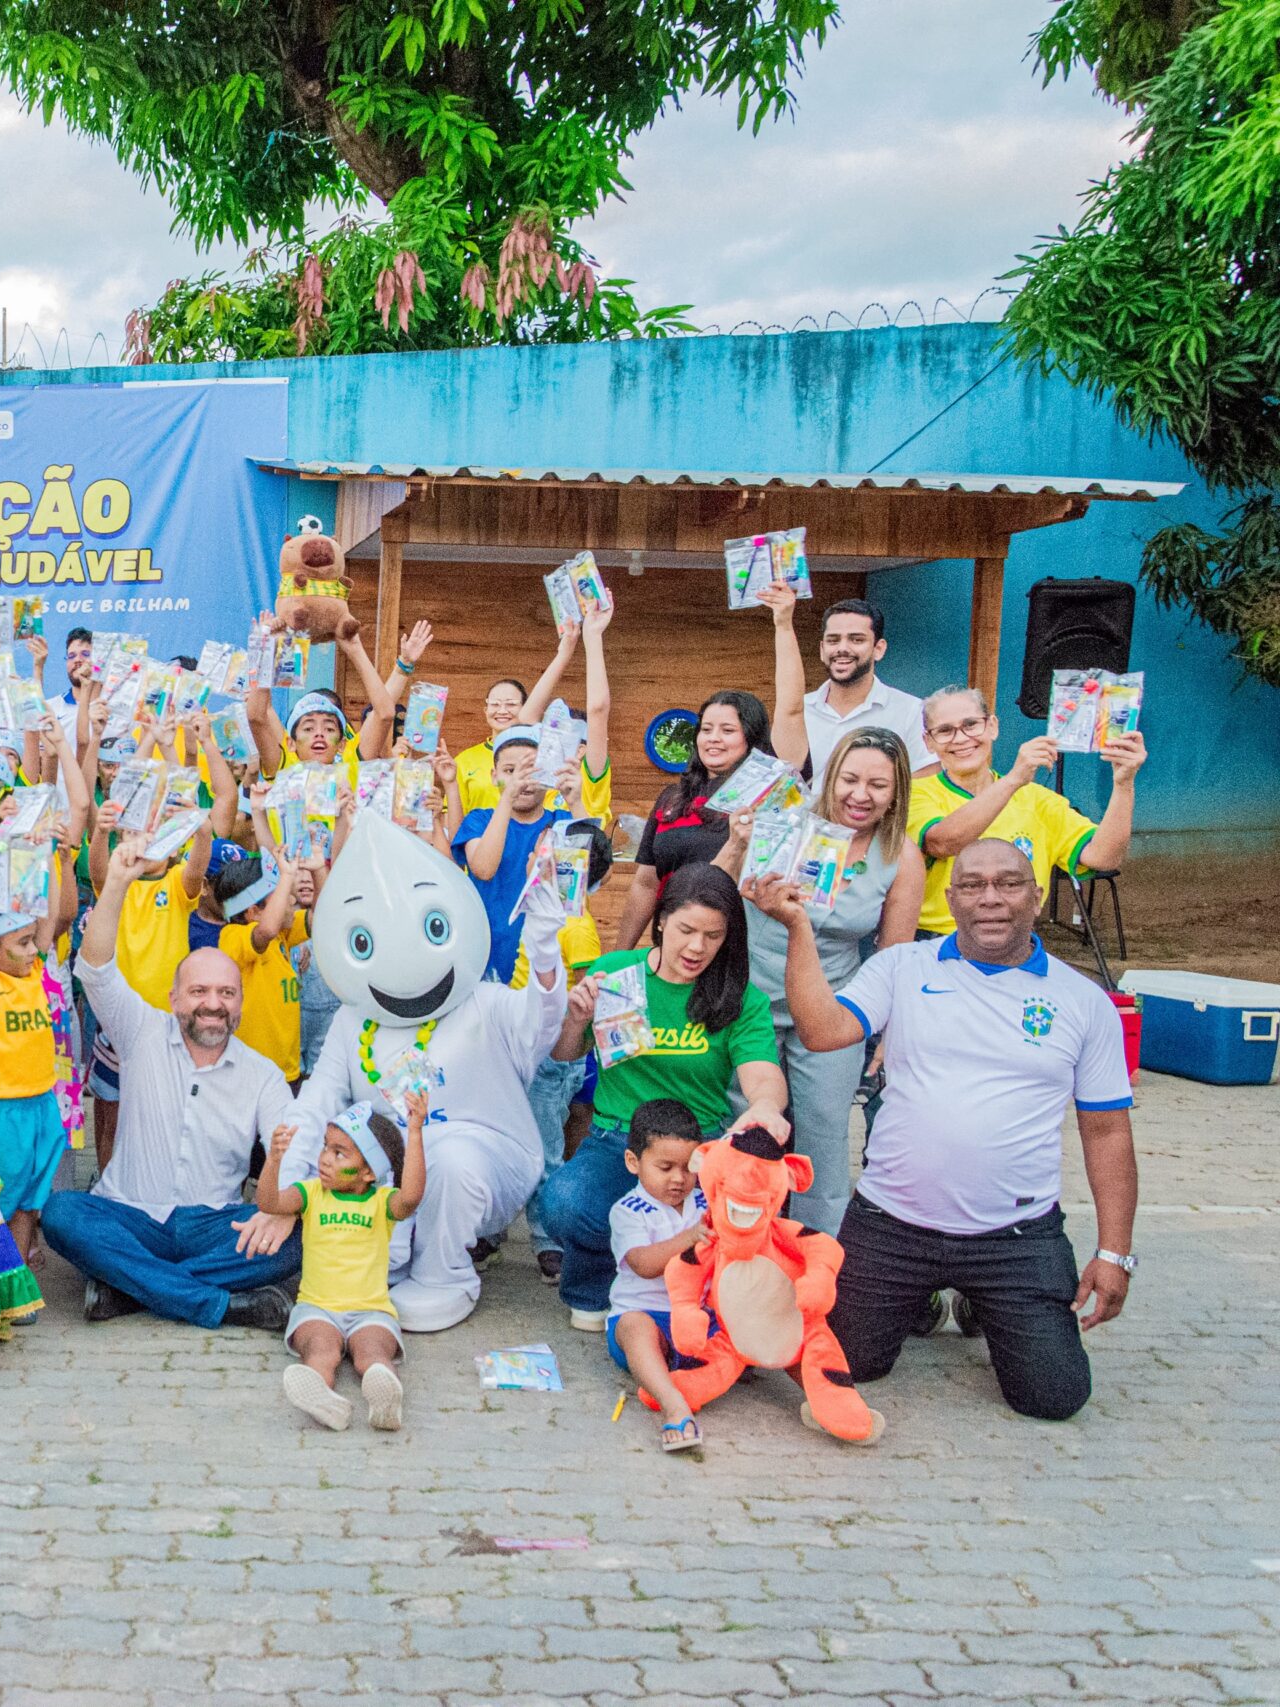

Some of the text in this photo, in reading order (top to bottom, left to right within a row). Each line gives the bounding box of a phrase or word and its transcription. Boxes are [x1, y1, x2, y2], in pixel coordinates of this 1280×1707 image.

[55, 598, 94, 613] QUE
[99, 597, 190, 613] BRILHAM
[280, 977, 301, 1003] 10
[319, 1211, 373, 1229] BRASIL
